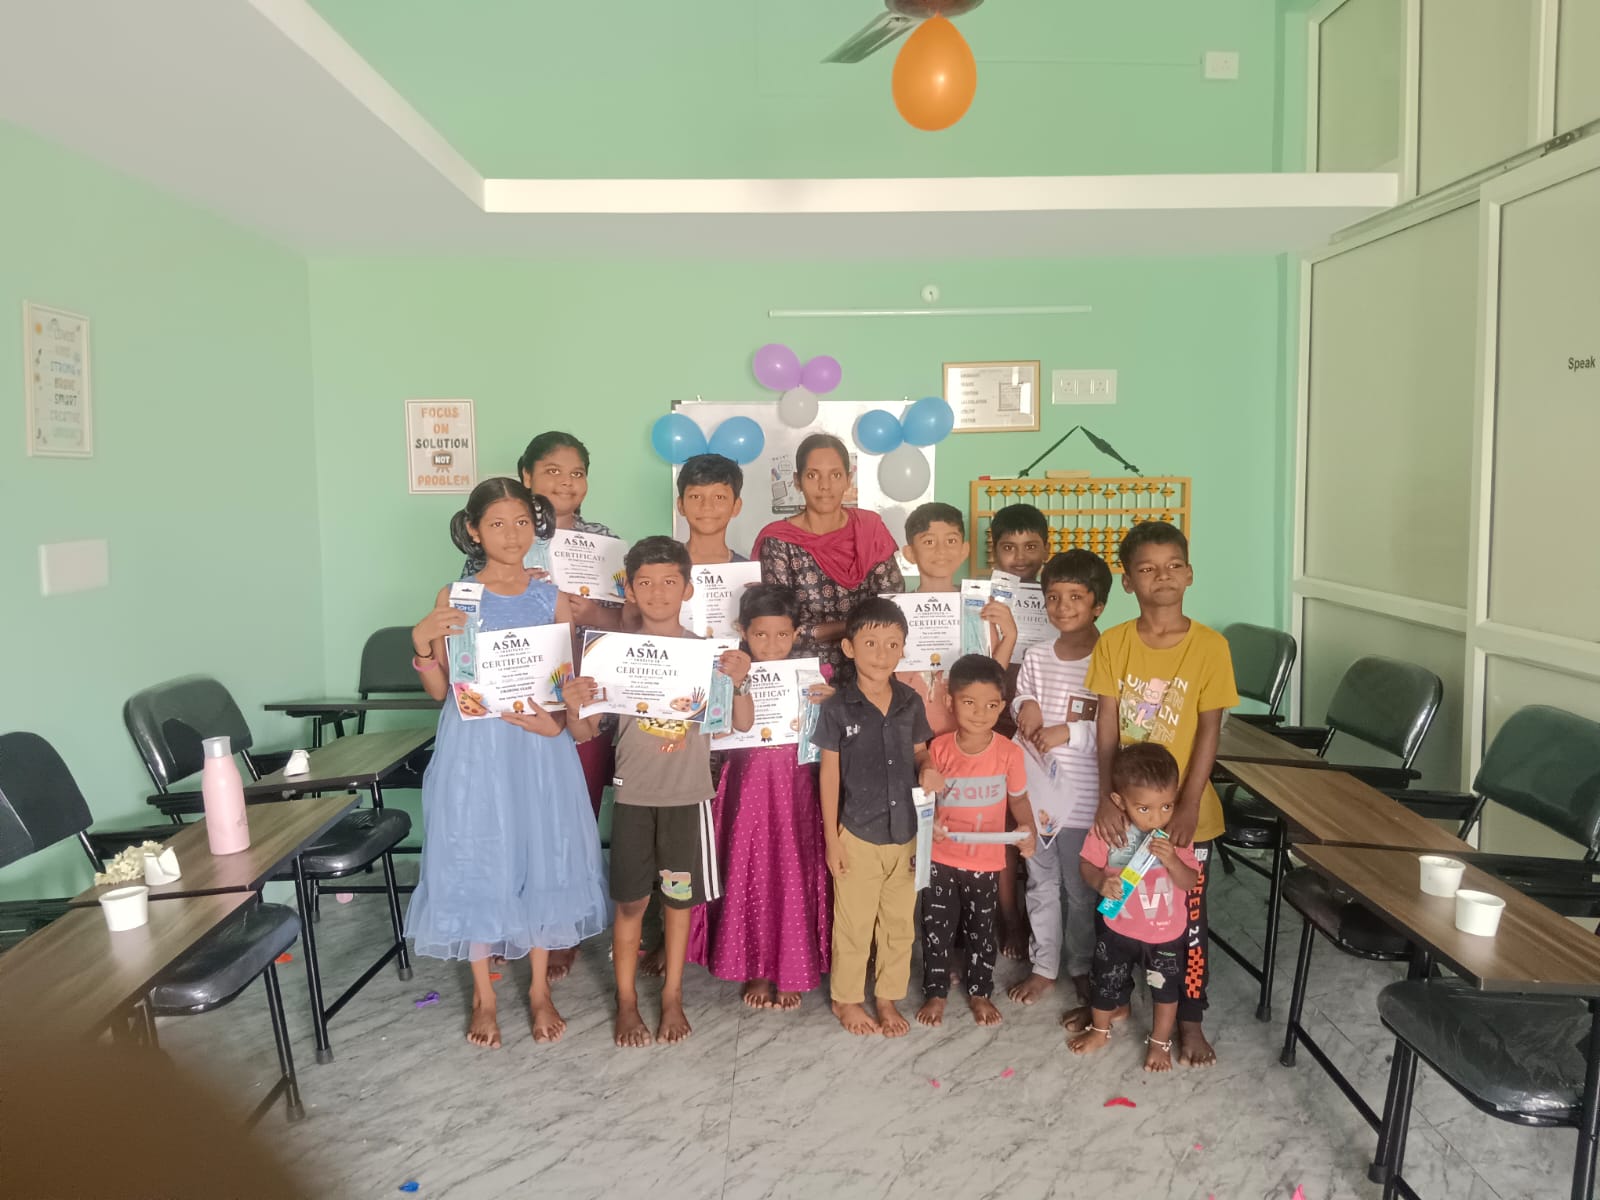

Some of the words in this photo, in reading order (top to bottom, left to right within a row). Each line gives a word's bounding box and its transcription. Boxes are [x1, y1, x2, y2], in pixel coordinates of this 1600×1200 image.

[1568, 355, 1596, 373] Speak
[421, 407, 459, 418] FOCUS
[433, 423, 449, 434] ON
[415, 438, 468, 448] SOLUTION
[435, 456, 451, 464] NOT
[417, 474, 470, 486] PROBLEM
[564, 538, 596, 549] ASMA
[696, 575, 723, 584] SMA
[915, 603, 952, 612] ASMA
[492, 638, 530, 651] ASMA
[626, 647, 669, 660] ASMA
[482, 654, 544, 669] CERTIFICATE
[752, 672, 781, 683] SMA
[1188, 926, 1200, 947] 21
